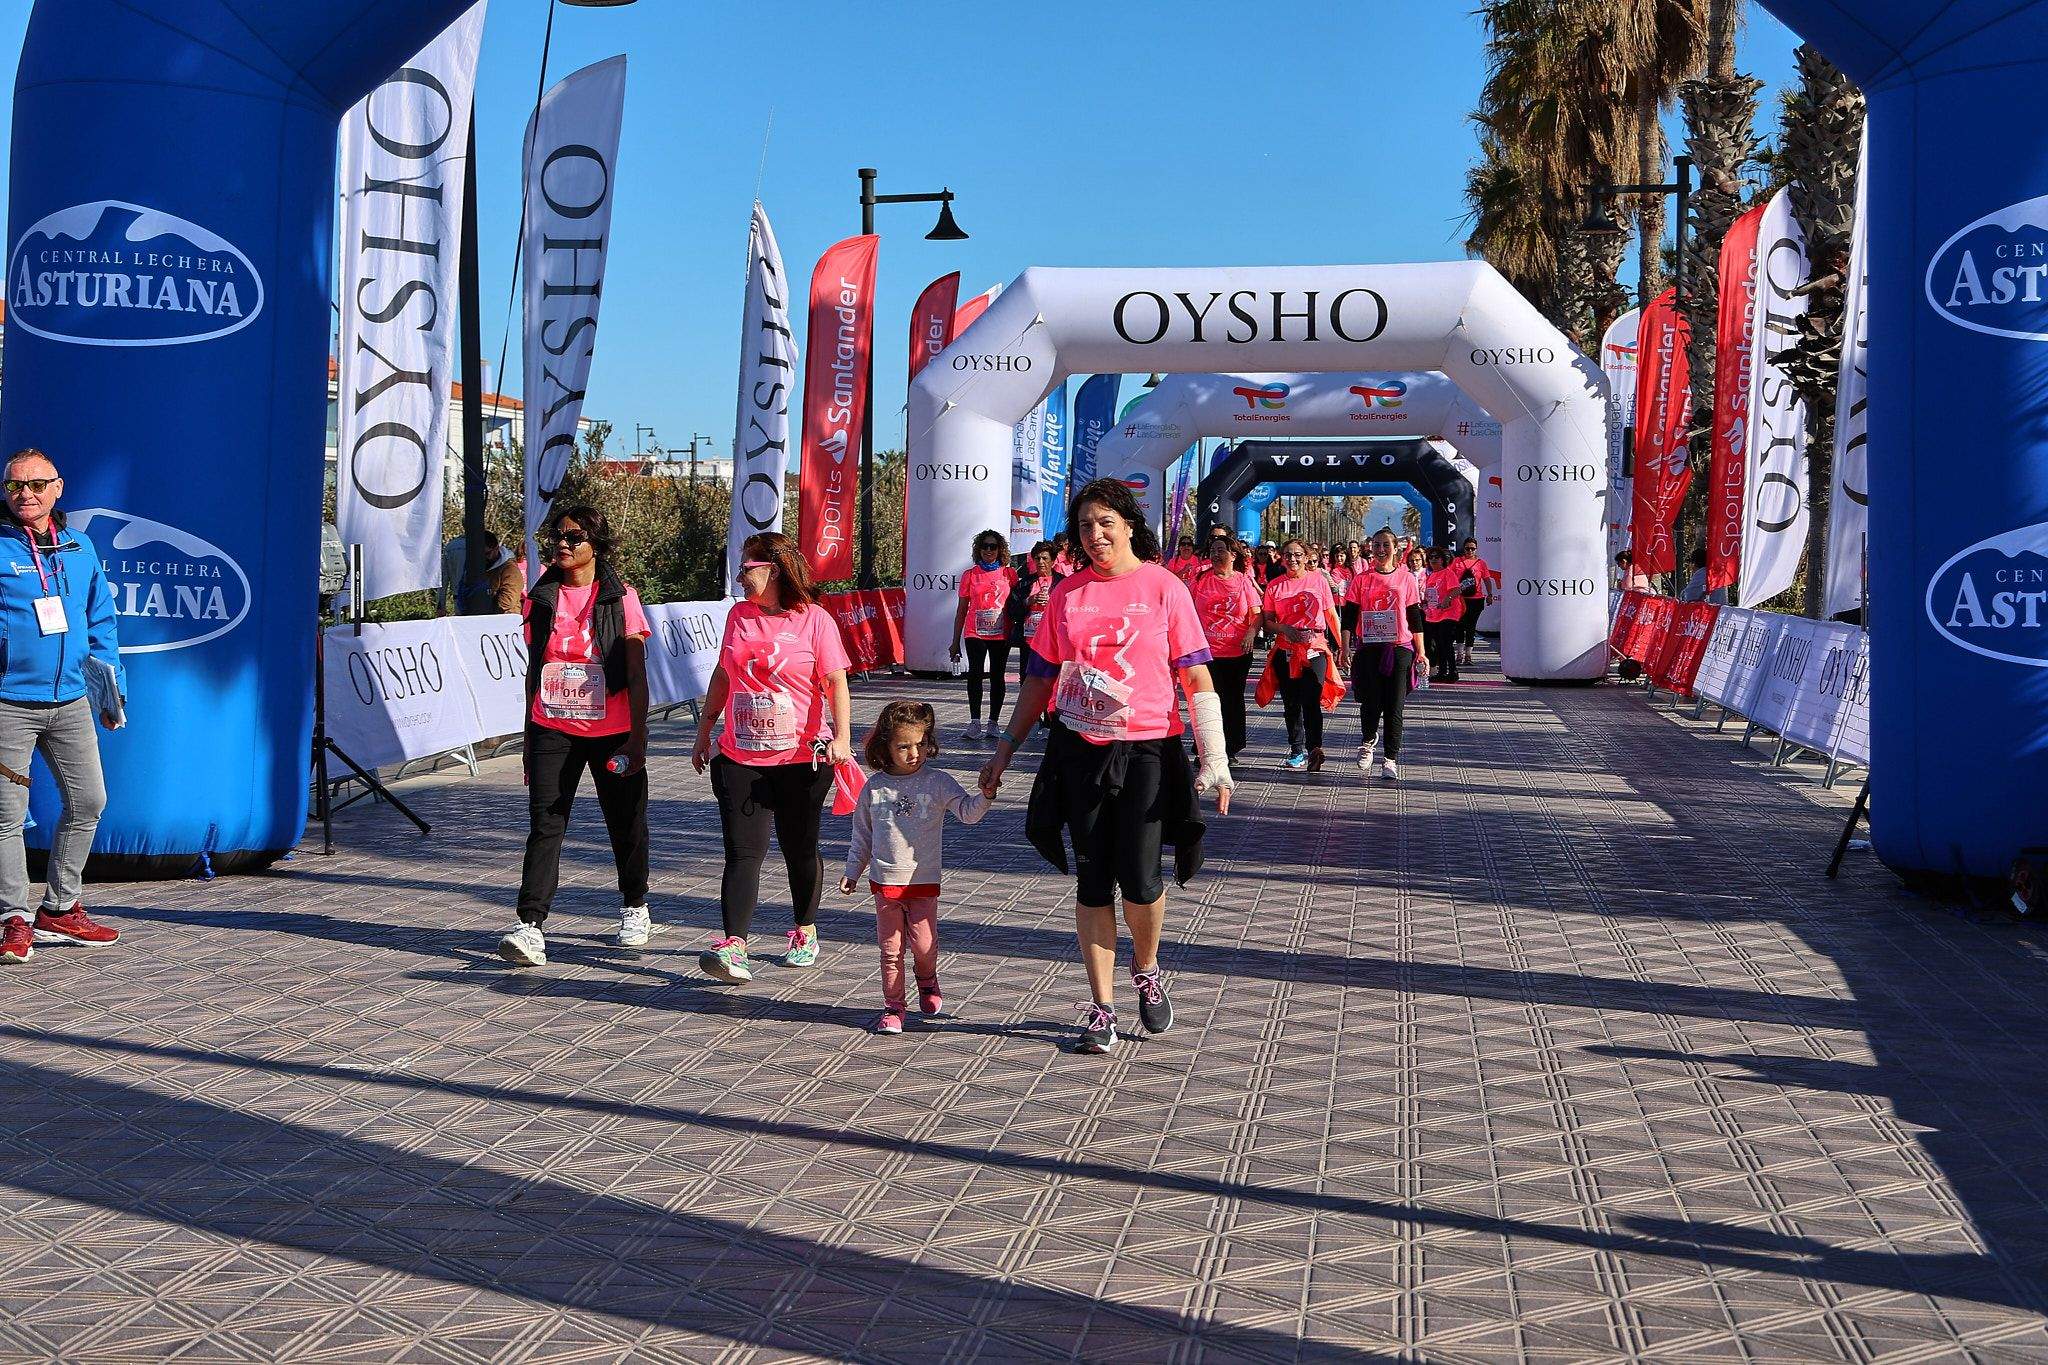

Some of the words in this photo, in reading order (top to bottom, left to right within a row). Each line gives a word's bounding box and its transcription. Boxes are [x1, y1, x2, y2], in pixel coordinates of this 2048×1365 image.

[40, 250, 123, 264] CENTRAL
[134, 252, 235, 274] LECHERA
[14, 254, 243, 317] ASTURIANA
[350, 66, 453, 509] OYSHO
[537, 144, 609, 503] OYSHO
[925, 314, 943, 363] der
[1113, 288, 1389, 345] OYSHO
[828, 276, 860, 425] Santander
[952, 354, 1033, 373] OYSHO
[1469, 347, 1555, 367] OYSHO
[1233, 414, 1291, 424] TotalEnergies
[1349, 413, 1408, 422] TotalEnergies
[915, 464, 989, 482] OYSHO
[1041, 413, 1066, 495] Marlene
[1270, 455, 1396, 466] VOLVO
[1517, 464, 1596, 483] OYSHO
[817, 471, 842, 558] Sports
[1720, 460, 1743, 558] Sports
[121, 561, 222, 578] LECHERA
[913, 574, 960, 591] OYSH
[1516, 578, 1595, 597] OYSHO
[480, 632, 531, 681] OYS
[662, 613, 718, 658] OYSHO
[348, 642, 443, 706] OYSHO
[1773, 634, 1813, 686] OYSHO
[1819, 646, 1870, 706] OYSHO
[562, 688, 586, 699] 016
[751, 718, 775, 728] 016
